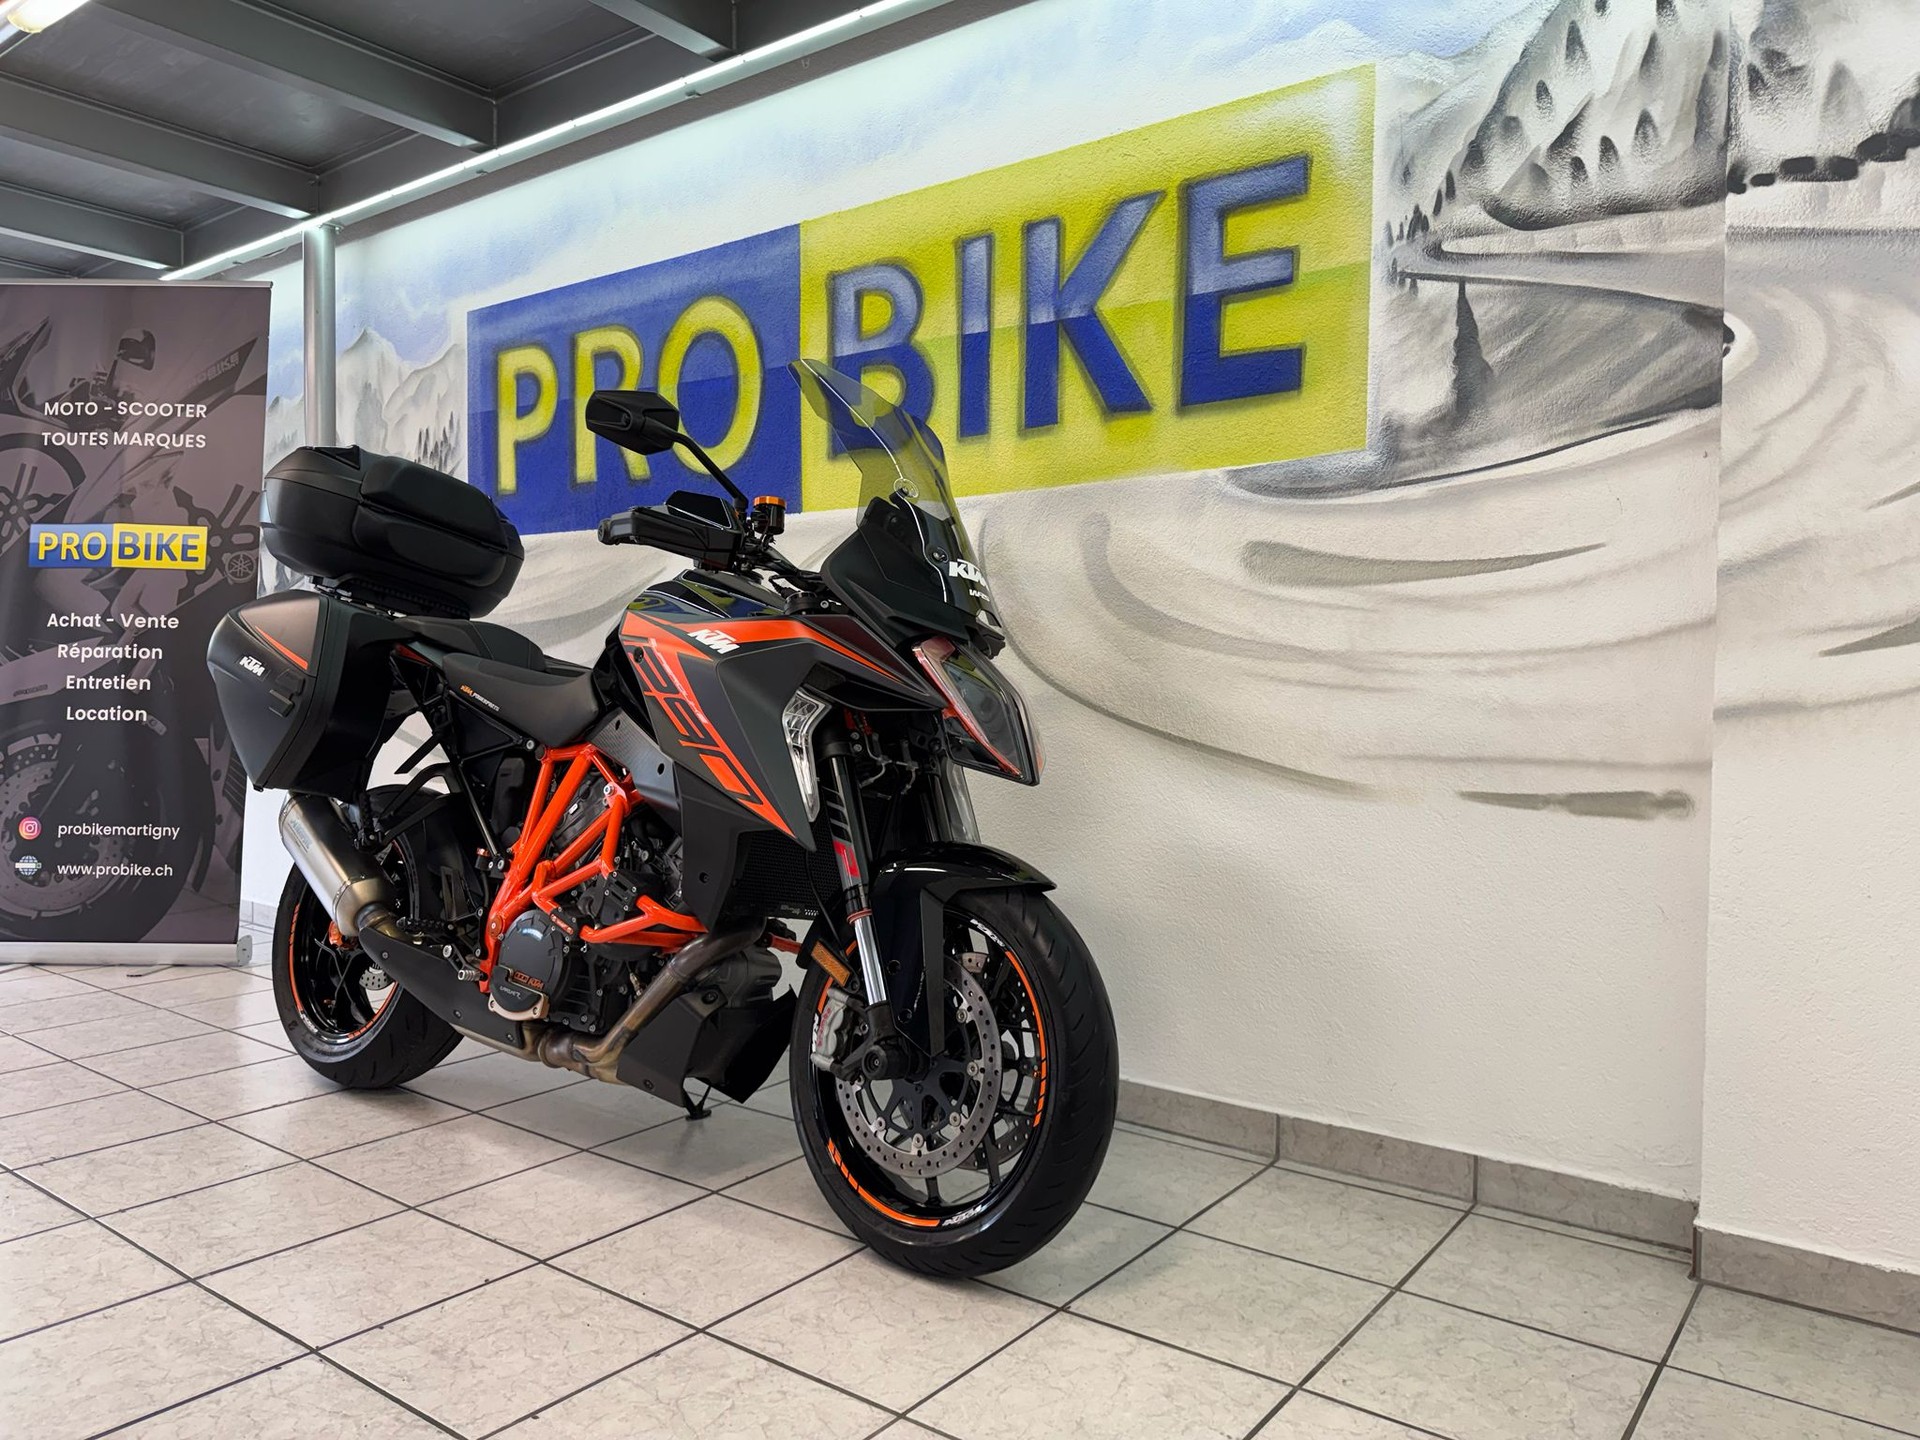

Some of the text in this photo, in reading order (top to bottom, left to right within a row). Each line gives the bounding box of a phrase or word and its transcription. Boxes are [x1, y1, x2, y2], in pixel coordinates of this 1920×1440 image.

[496, 153, 1313, 494] PRO BIKE
[44, 401, 98, 416] MOTO
[117, 401, 207, 418] SCOOTER
[41, 431, 206, 449] TOUTES MARQUES
[37, 531, 200, 562] PRO BIKE
[46, 612, 102, 628] Achat
[120, 613, 180, 629] Vente
[687, 628, 740, 654] KTM
[57, 642, 163, 662] Réparation
[239, 655, 265, 677] KTM
[66, 674, 152, 691] Entretien
[66, 705, 148, 722] Location
[57, 822, 181, 840] probikemartigny
[57, 862, 174, 879] www.probike.ch
